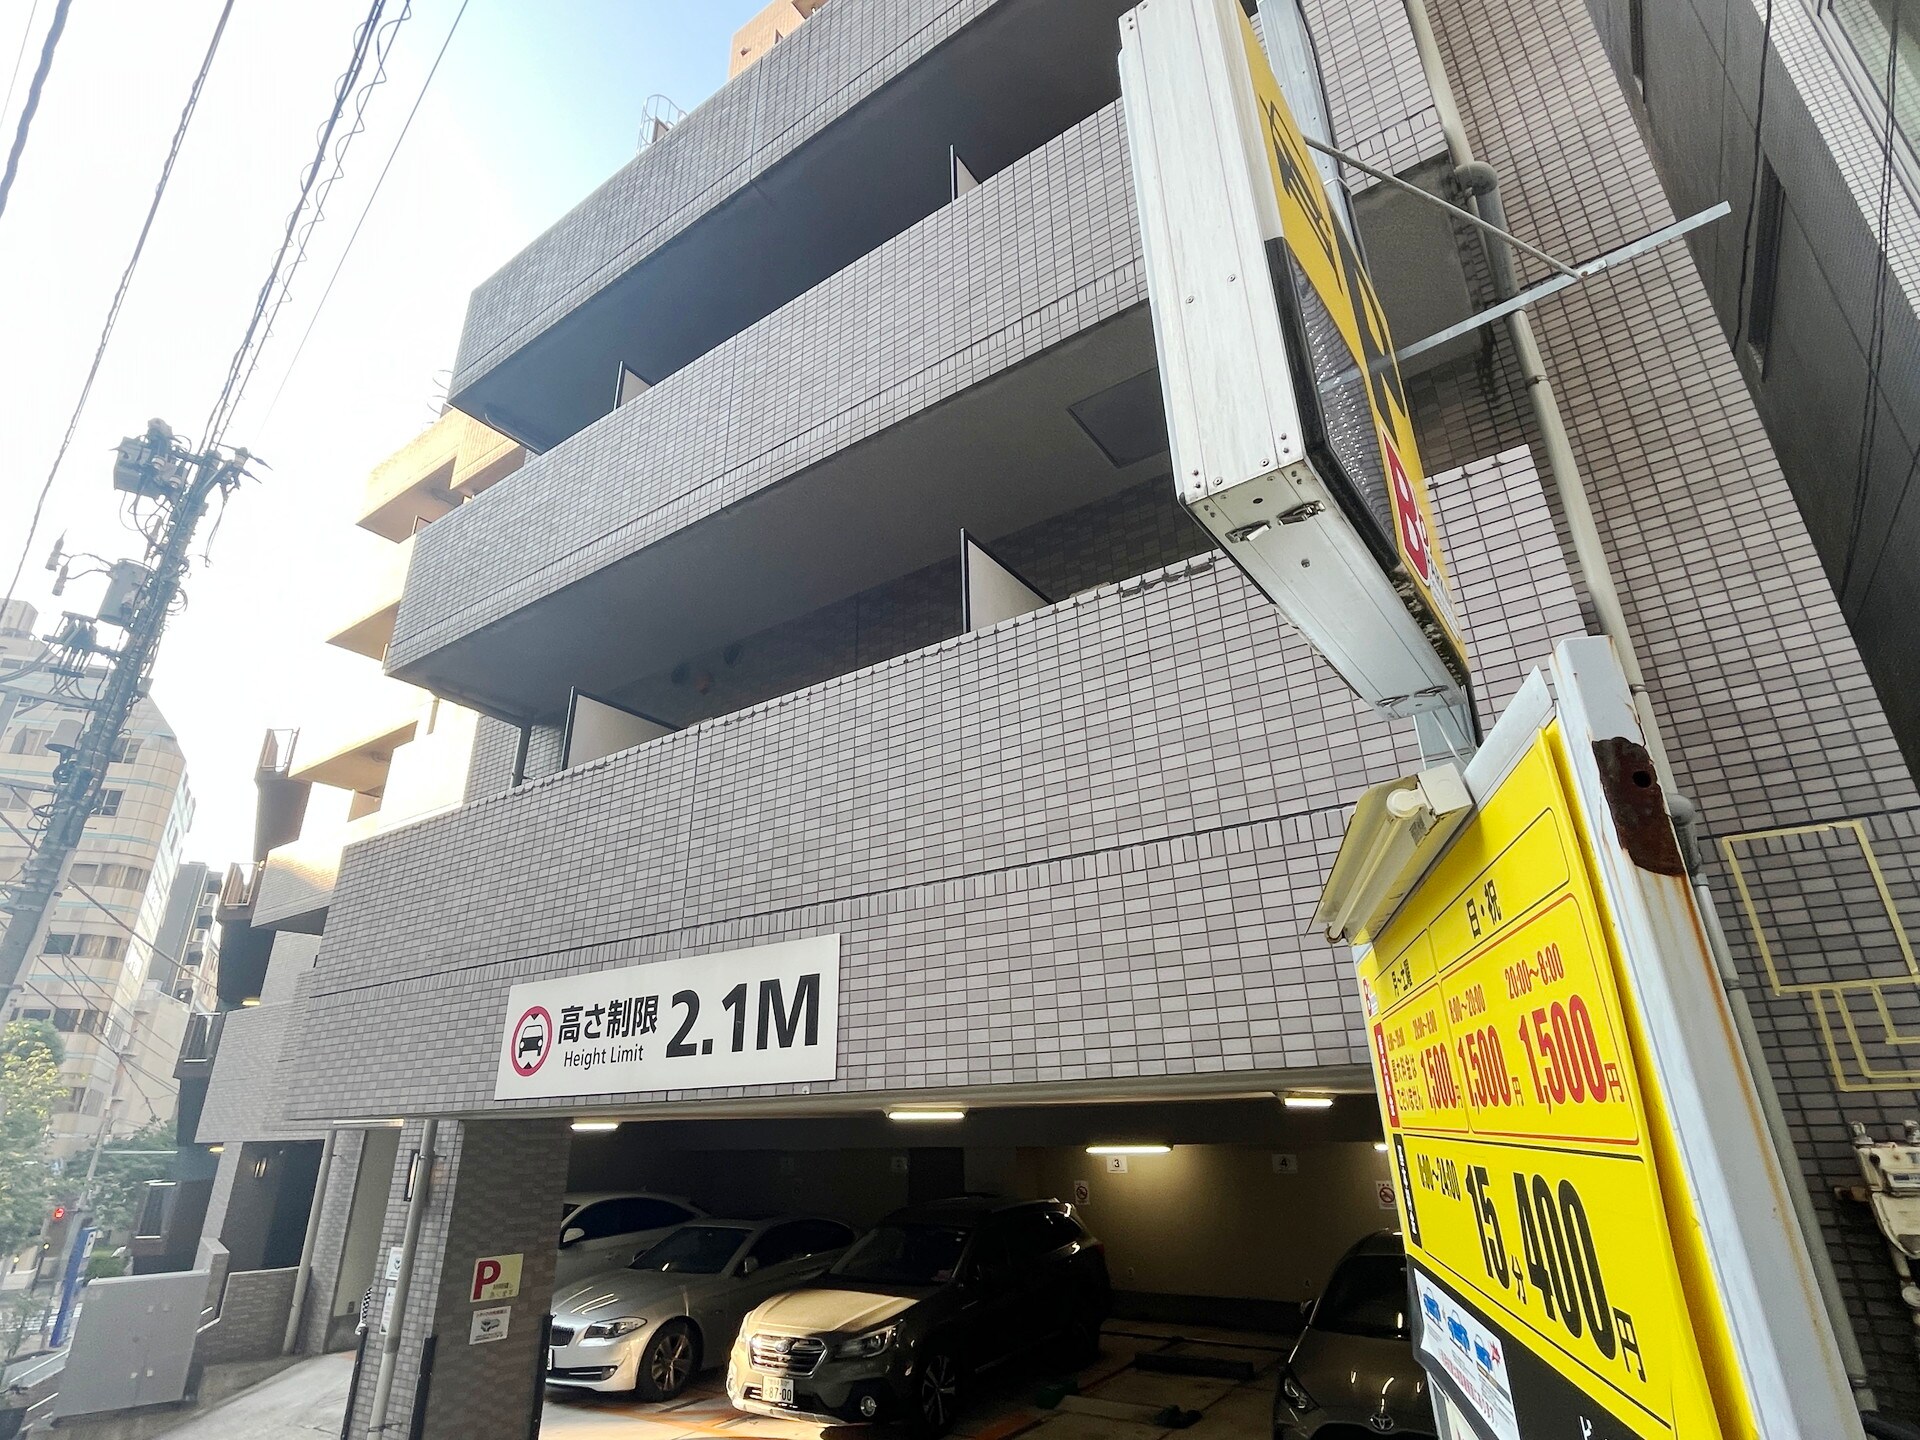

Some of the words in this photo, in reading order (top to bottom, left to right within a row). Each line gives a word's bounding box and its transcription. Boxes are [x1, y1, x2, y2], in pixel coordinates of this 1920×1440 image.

[558, 995, 659, 1044] 高さ制限
[665, 973, 820, 1059] 2.1M
[563, 1050, 606, 1071] Height
[610, 1044, 644, 1065] Limit
[1518, 994, 1625, 1115] 1,500円
[1113, 1158, 1120, 1168] 3
[472, 1260, 502, 1301] P
